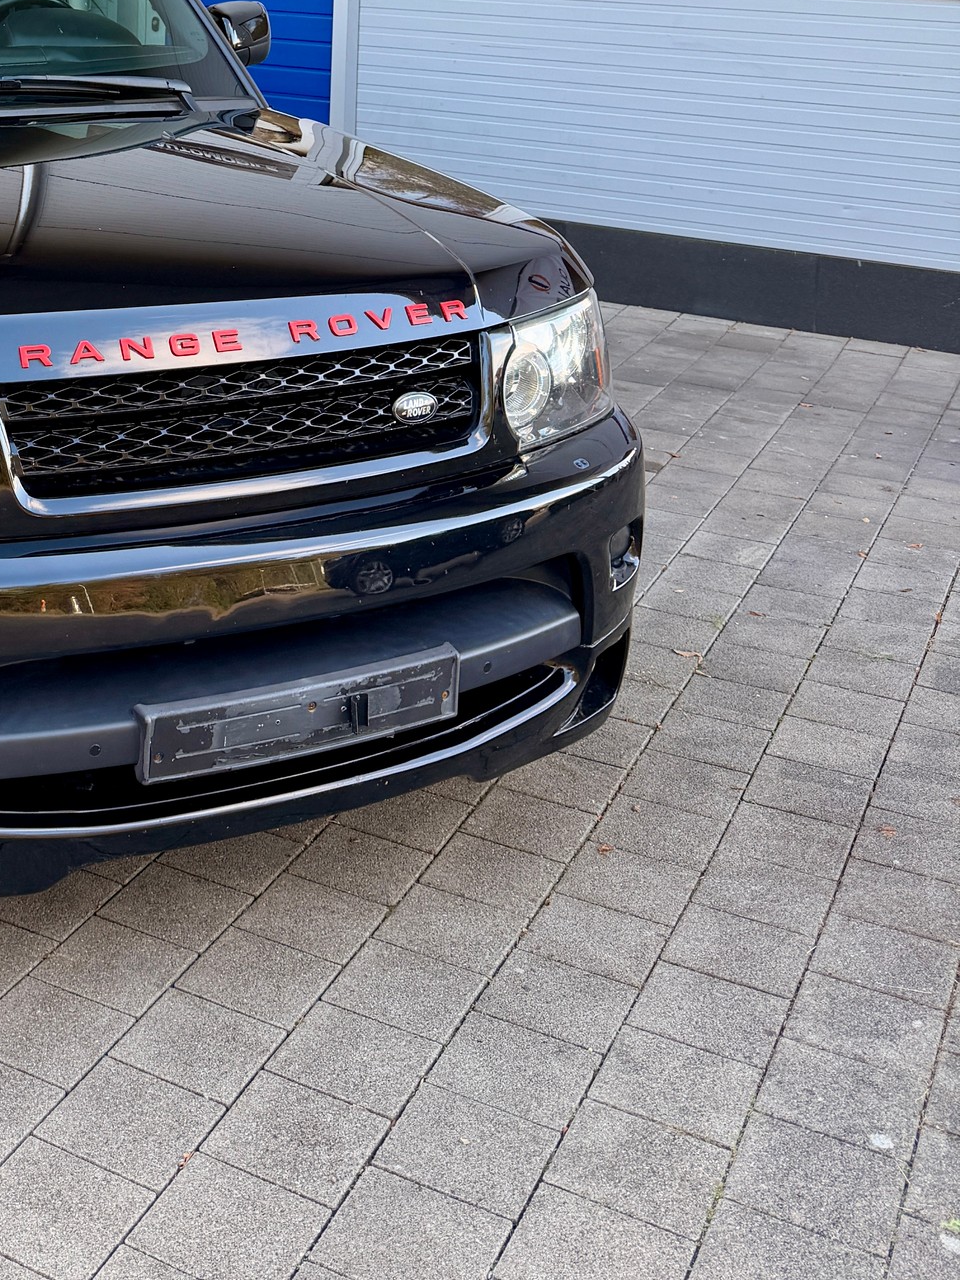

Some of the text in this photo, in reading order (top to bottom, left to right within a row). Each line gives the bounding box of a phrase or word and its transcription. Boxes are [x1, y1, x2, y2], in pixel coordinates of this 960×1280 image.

[19, 299, 468, 369] RANGE ROVER
[403, 398, 424, 410] LAND
[406, 406, 431, 418] ROVER
